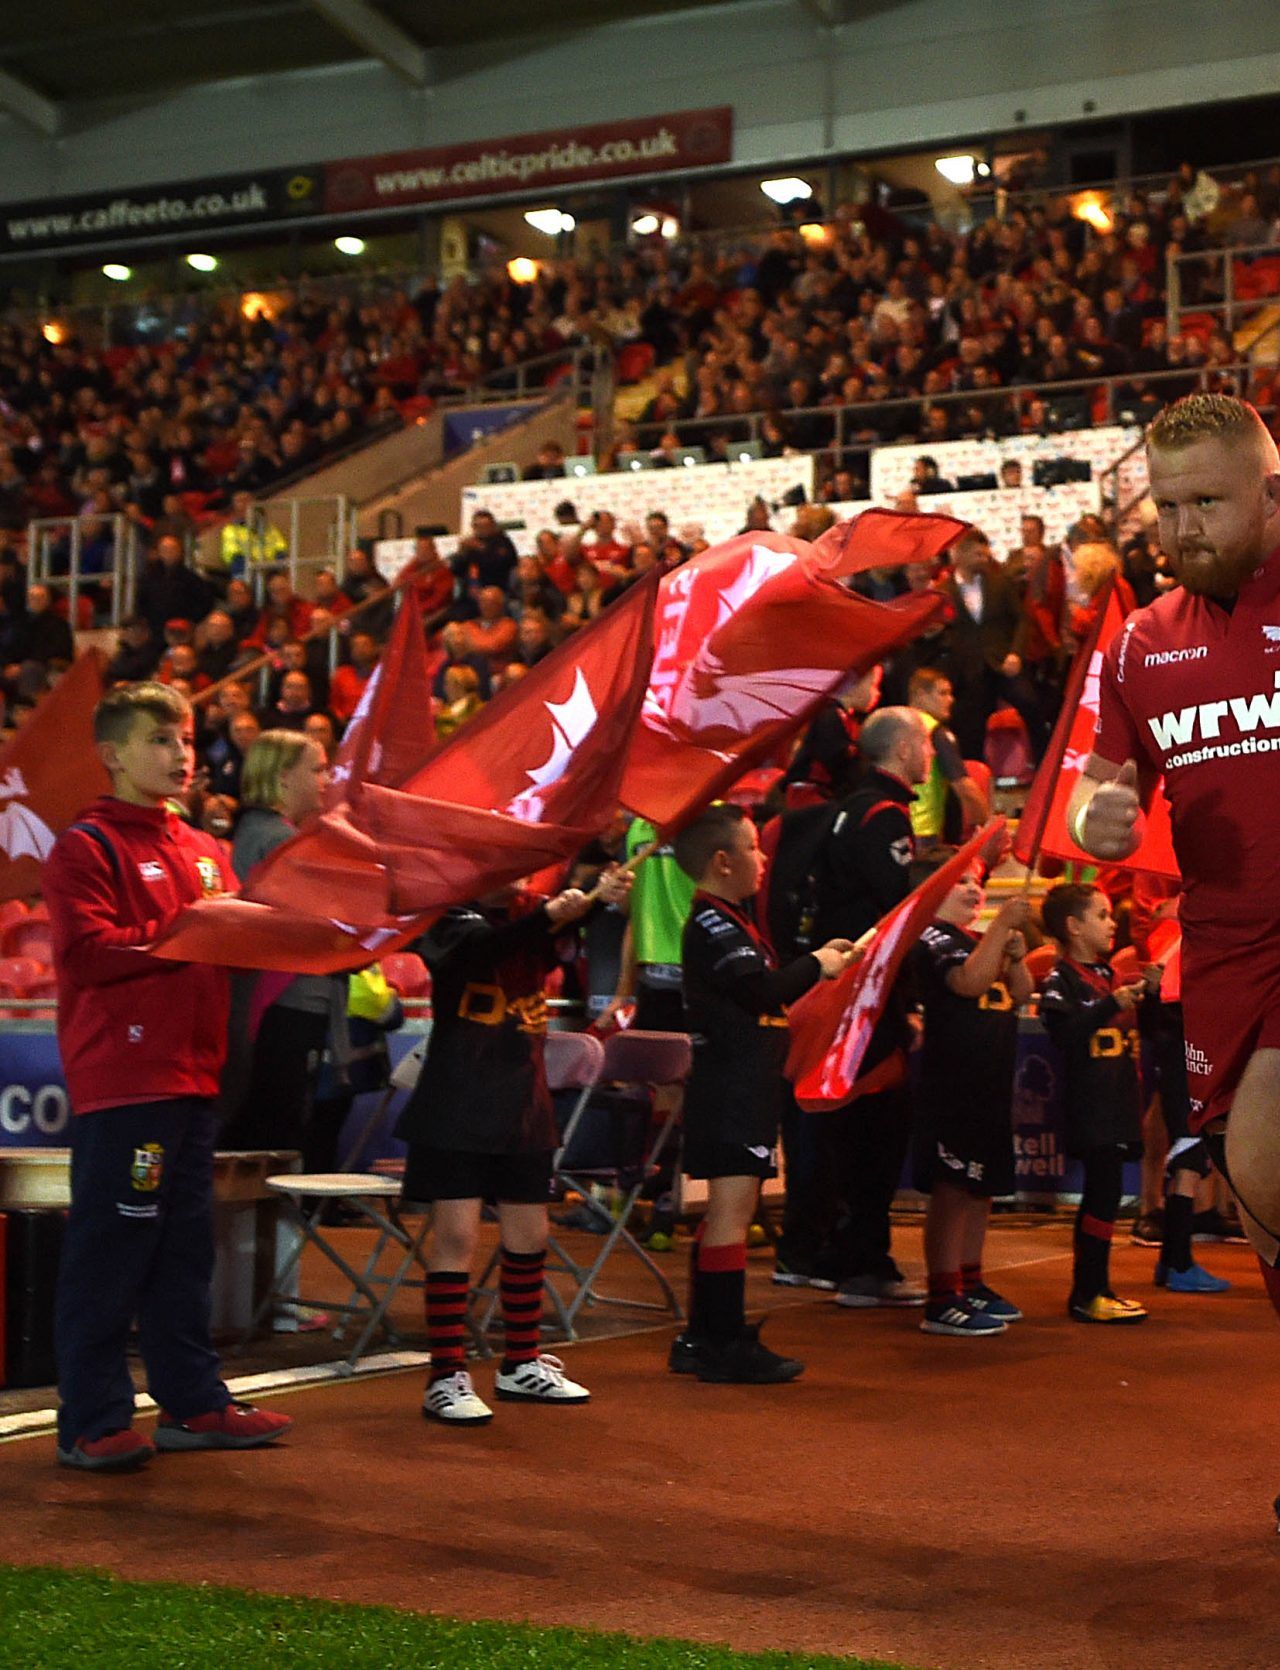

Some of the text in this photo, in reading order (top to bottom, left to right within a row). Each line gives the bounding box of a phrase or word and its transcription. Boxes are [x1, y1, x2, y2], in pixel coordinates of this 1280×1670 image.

[374, 128, 678, 195] www.celticpride.co.uk
[1144, 645, 1208, 668] macron
[1012, 1132, 1055, 1156] tell
[1014, 1152, 1066, 1176] well
